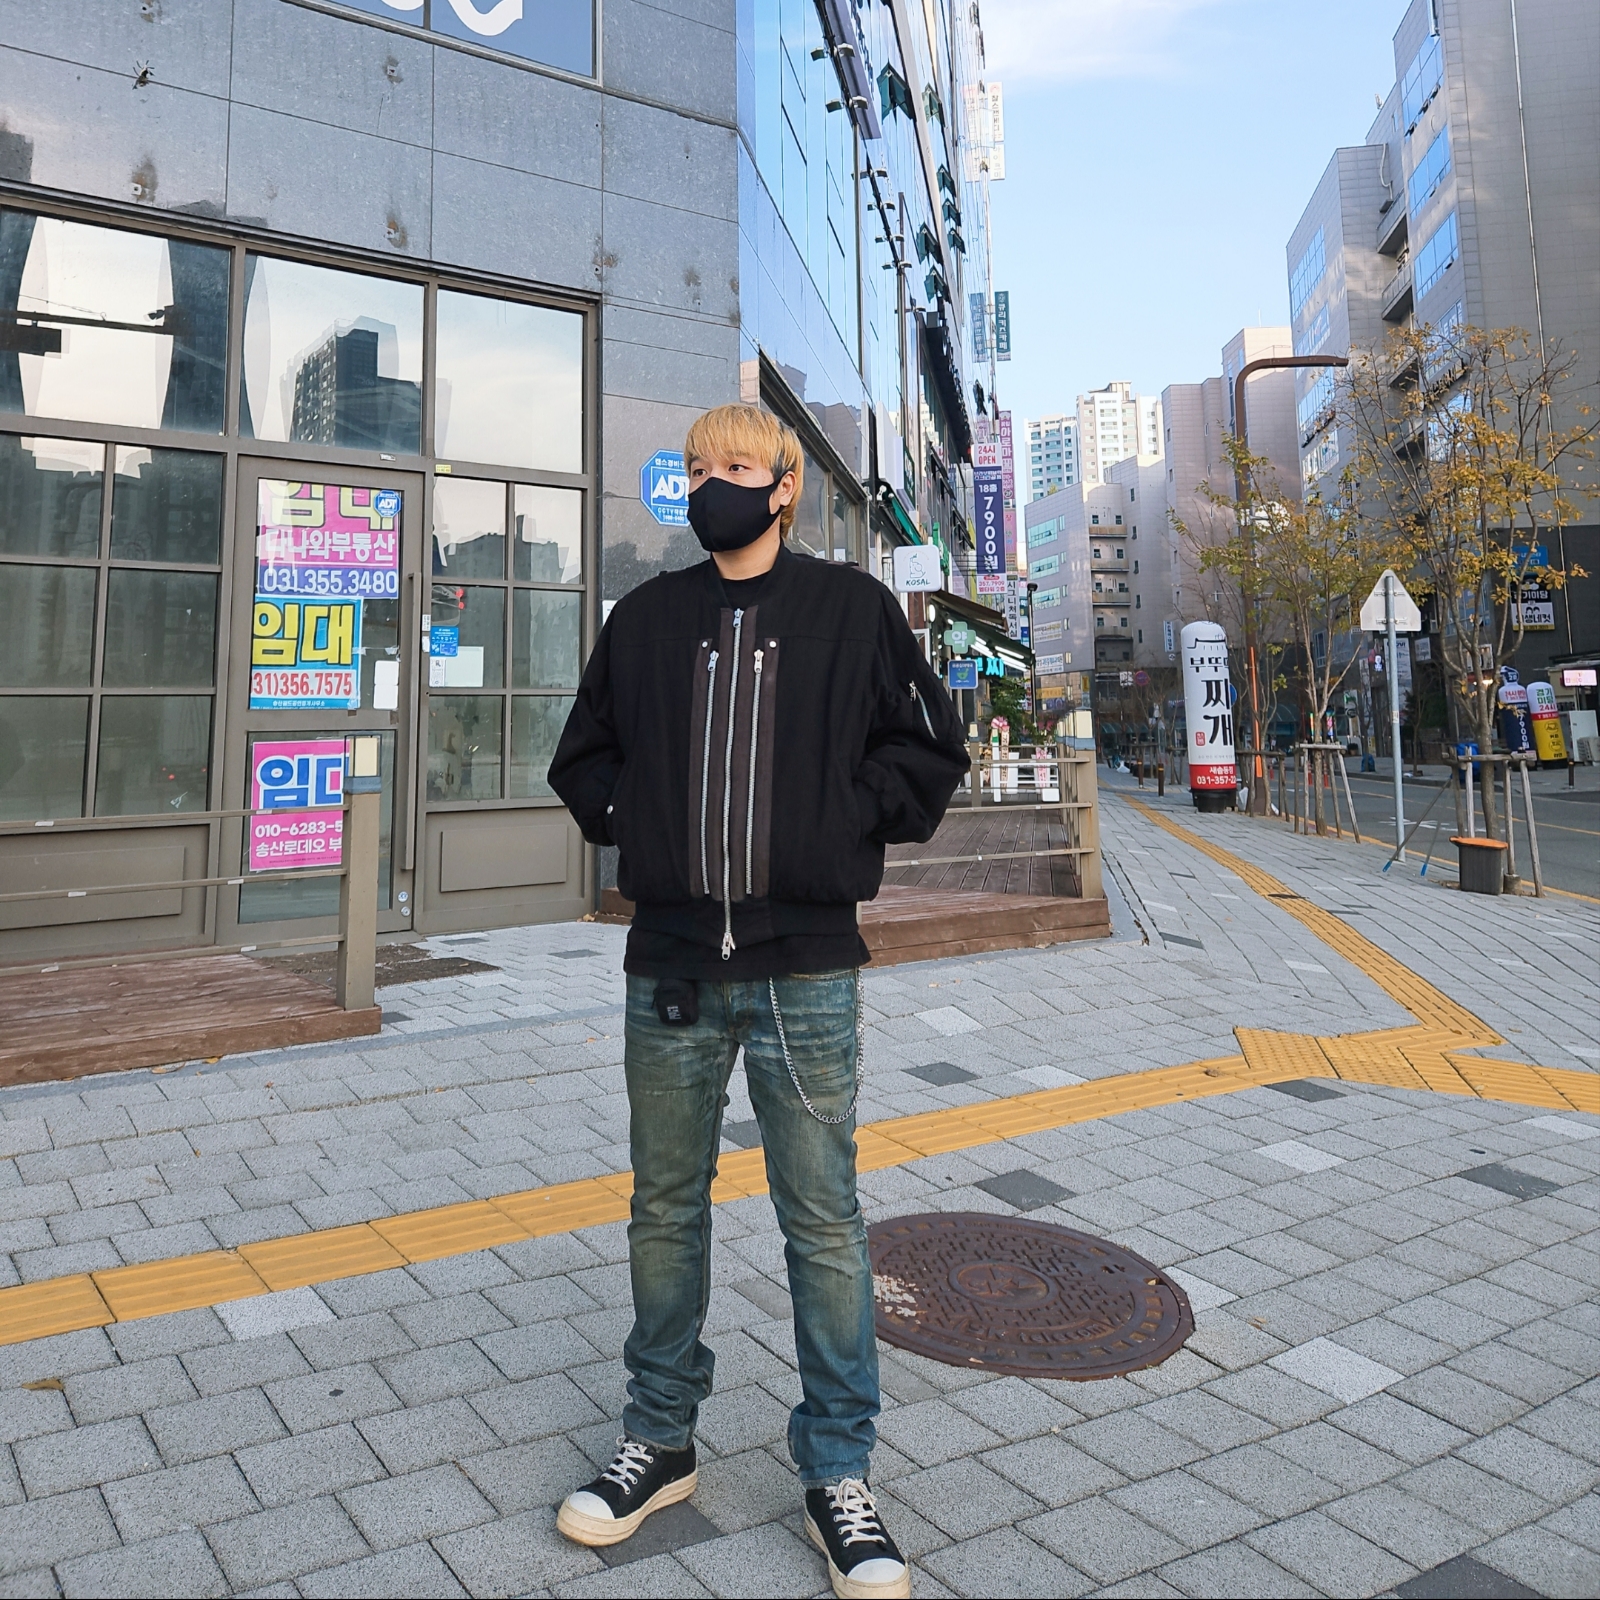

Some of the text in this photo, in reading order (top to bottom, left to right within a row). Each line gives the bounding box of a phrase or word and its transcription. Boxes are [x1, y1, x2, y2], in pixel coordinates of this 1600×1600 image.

[978, 456, 996, 465] OPEN
[652, 474, 690, 502] ADT
[378, 498, 397, 509] ADT
[265, 529, 395, 562] 다나와부동산
[264, 568, 397, 594] 031.355.3480
[252, 602, 354, 666] 임대
[952, 631, 967, 647] 약
[251, 672, 352, 697] 31)356.7575
[255, 838, 326, 858] 송산로데오
